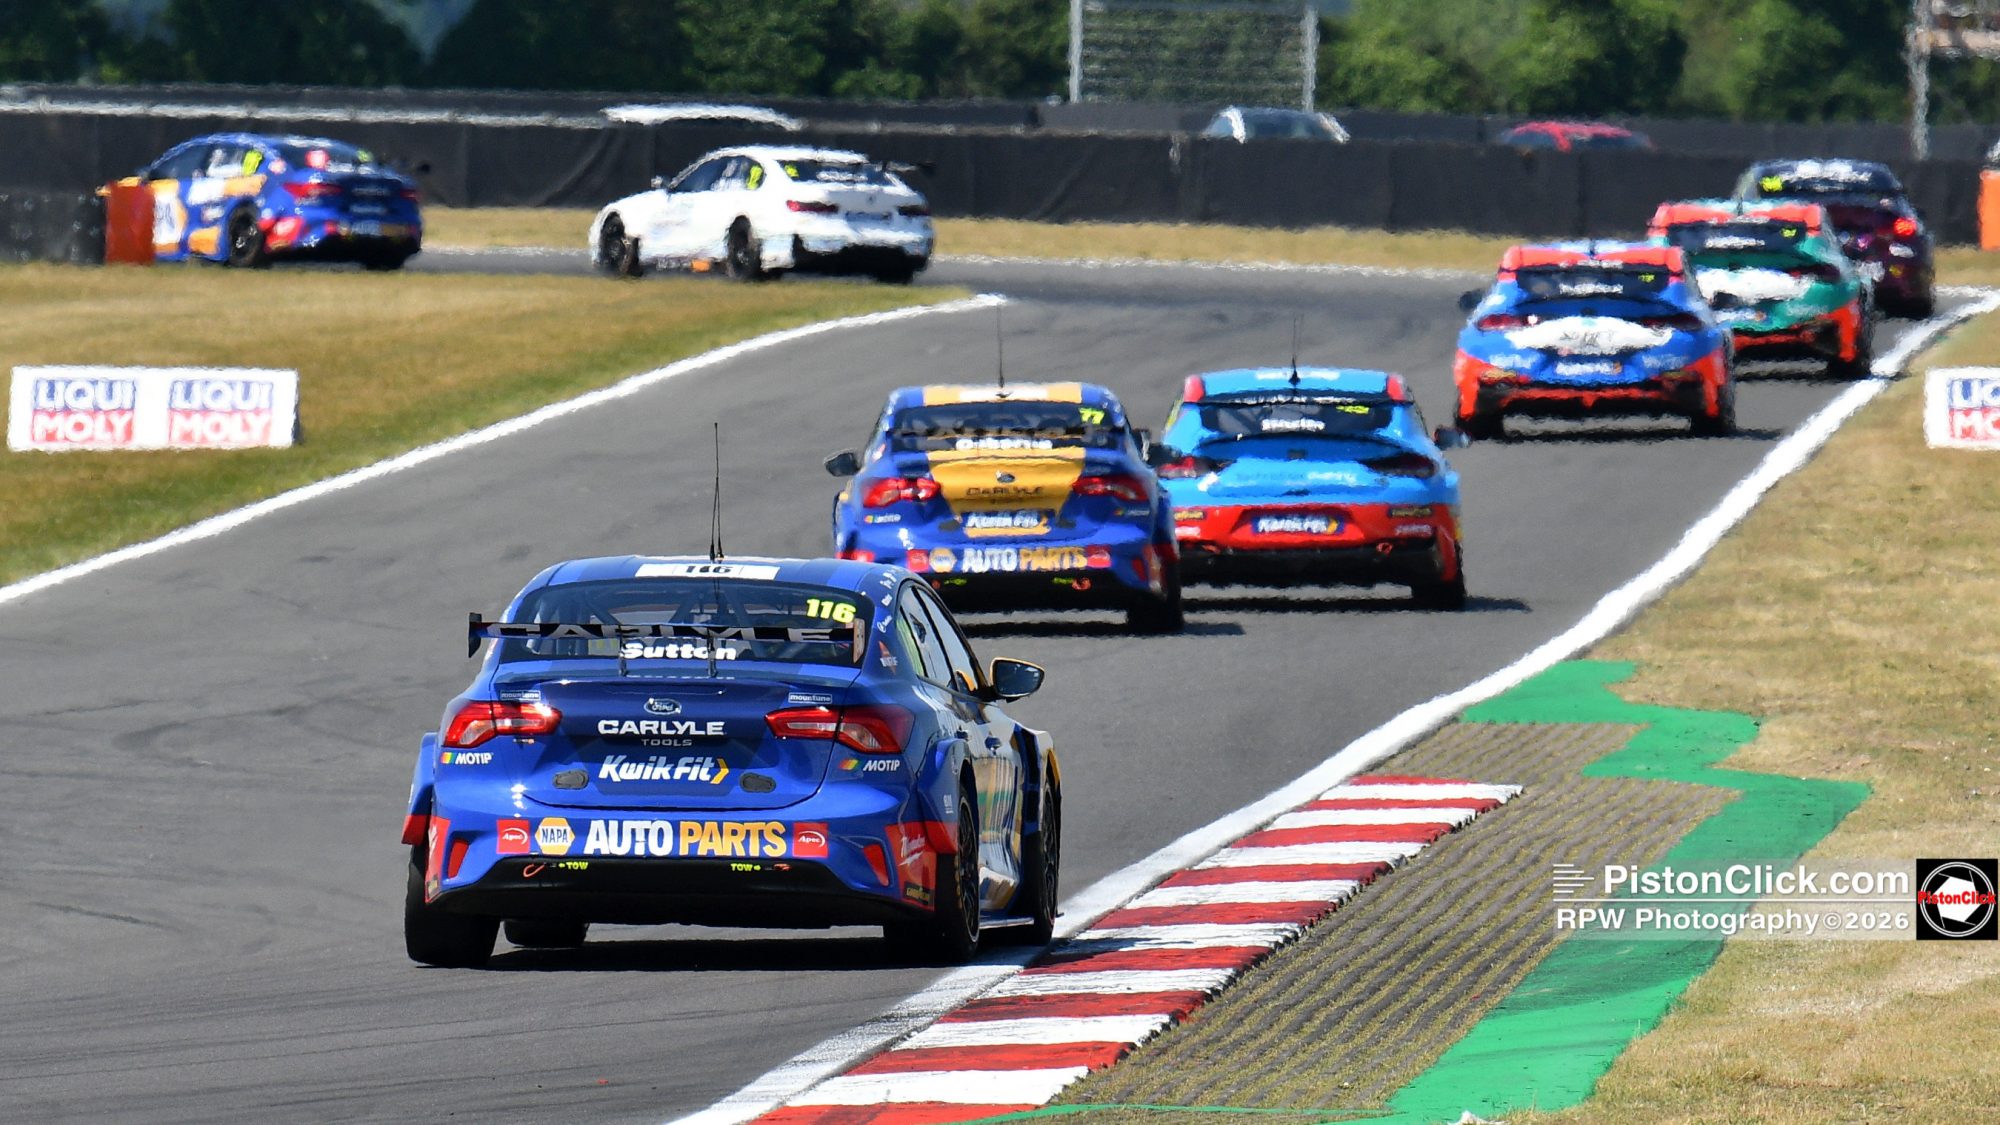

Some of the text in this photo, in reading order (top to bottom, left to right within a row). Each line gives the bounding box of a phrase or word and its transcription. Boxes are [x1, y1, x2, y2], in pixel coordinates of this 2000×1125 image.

[36, 379, 135, 410] LIQUI
[171, 380, 273, 410] LIQUI
[1078, 407, 1105, 425] 77
[33, 411, 134, 441] MOLY
[169, 411, 272, 442] MOLY
[962, 548, 1018, 573] AUTO
[1019, 547, 1087, 570] PARTS
[685, 565, 734, 575] 116
[806, 598, 857, 624] 116
[621, 641, 737, 661] Sutton
[789, 693, 832, 702] mountune
[598, 719, 726, 736] CARLYLE
[641, 738, 693, 747] TOOLS
[455, 752, 493, 765] MOTIP
[863, 759, 900, 771] MOTIP
[541, 828, 569, 844] NAPA
[584, 819, 787, 857] AUTO PARTS
[798, 834, 821, 844] Apec
[565, 861, 589, 870] TOW
[730, 863, 753, 872] TOW
